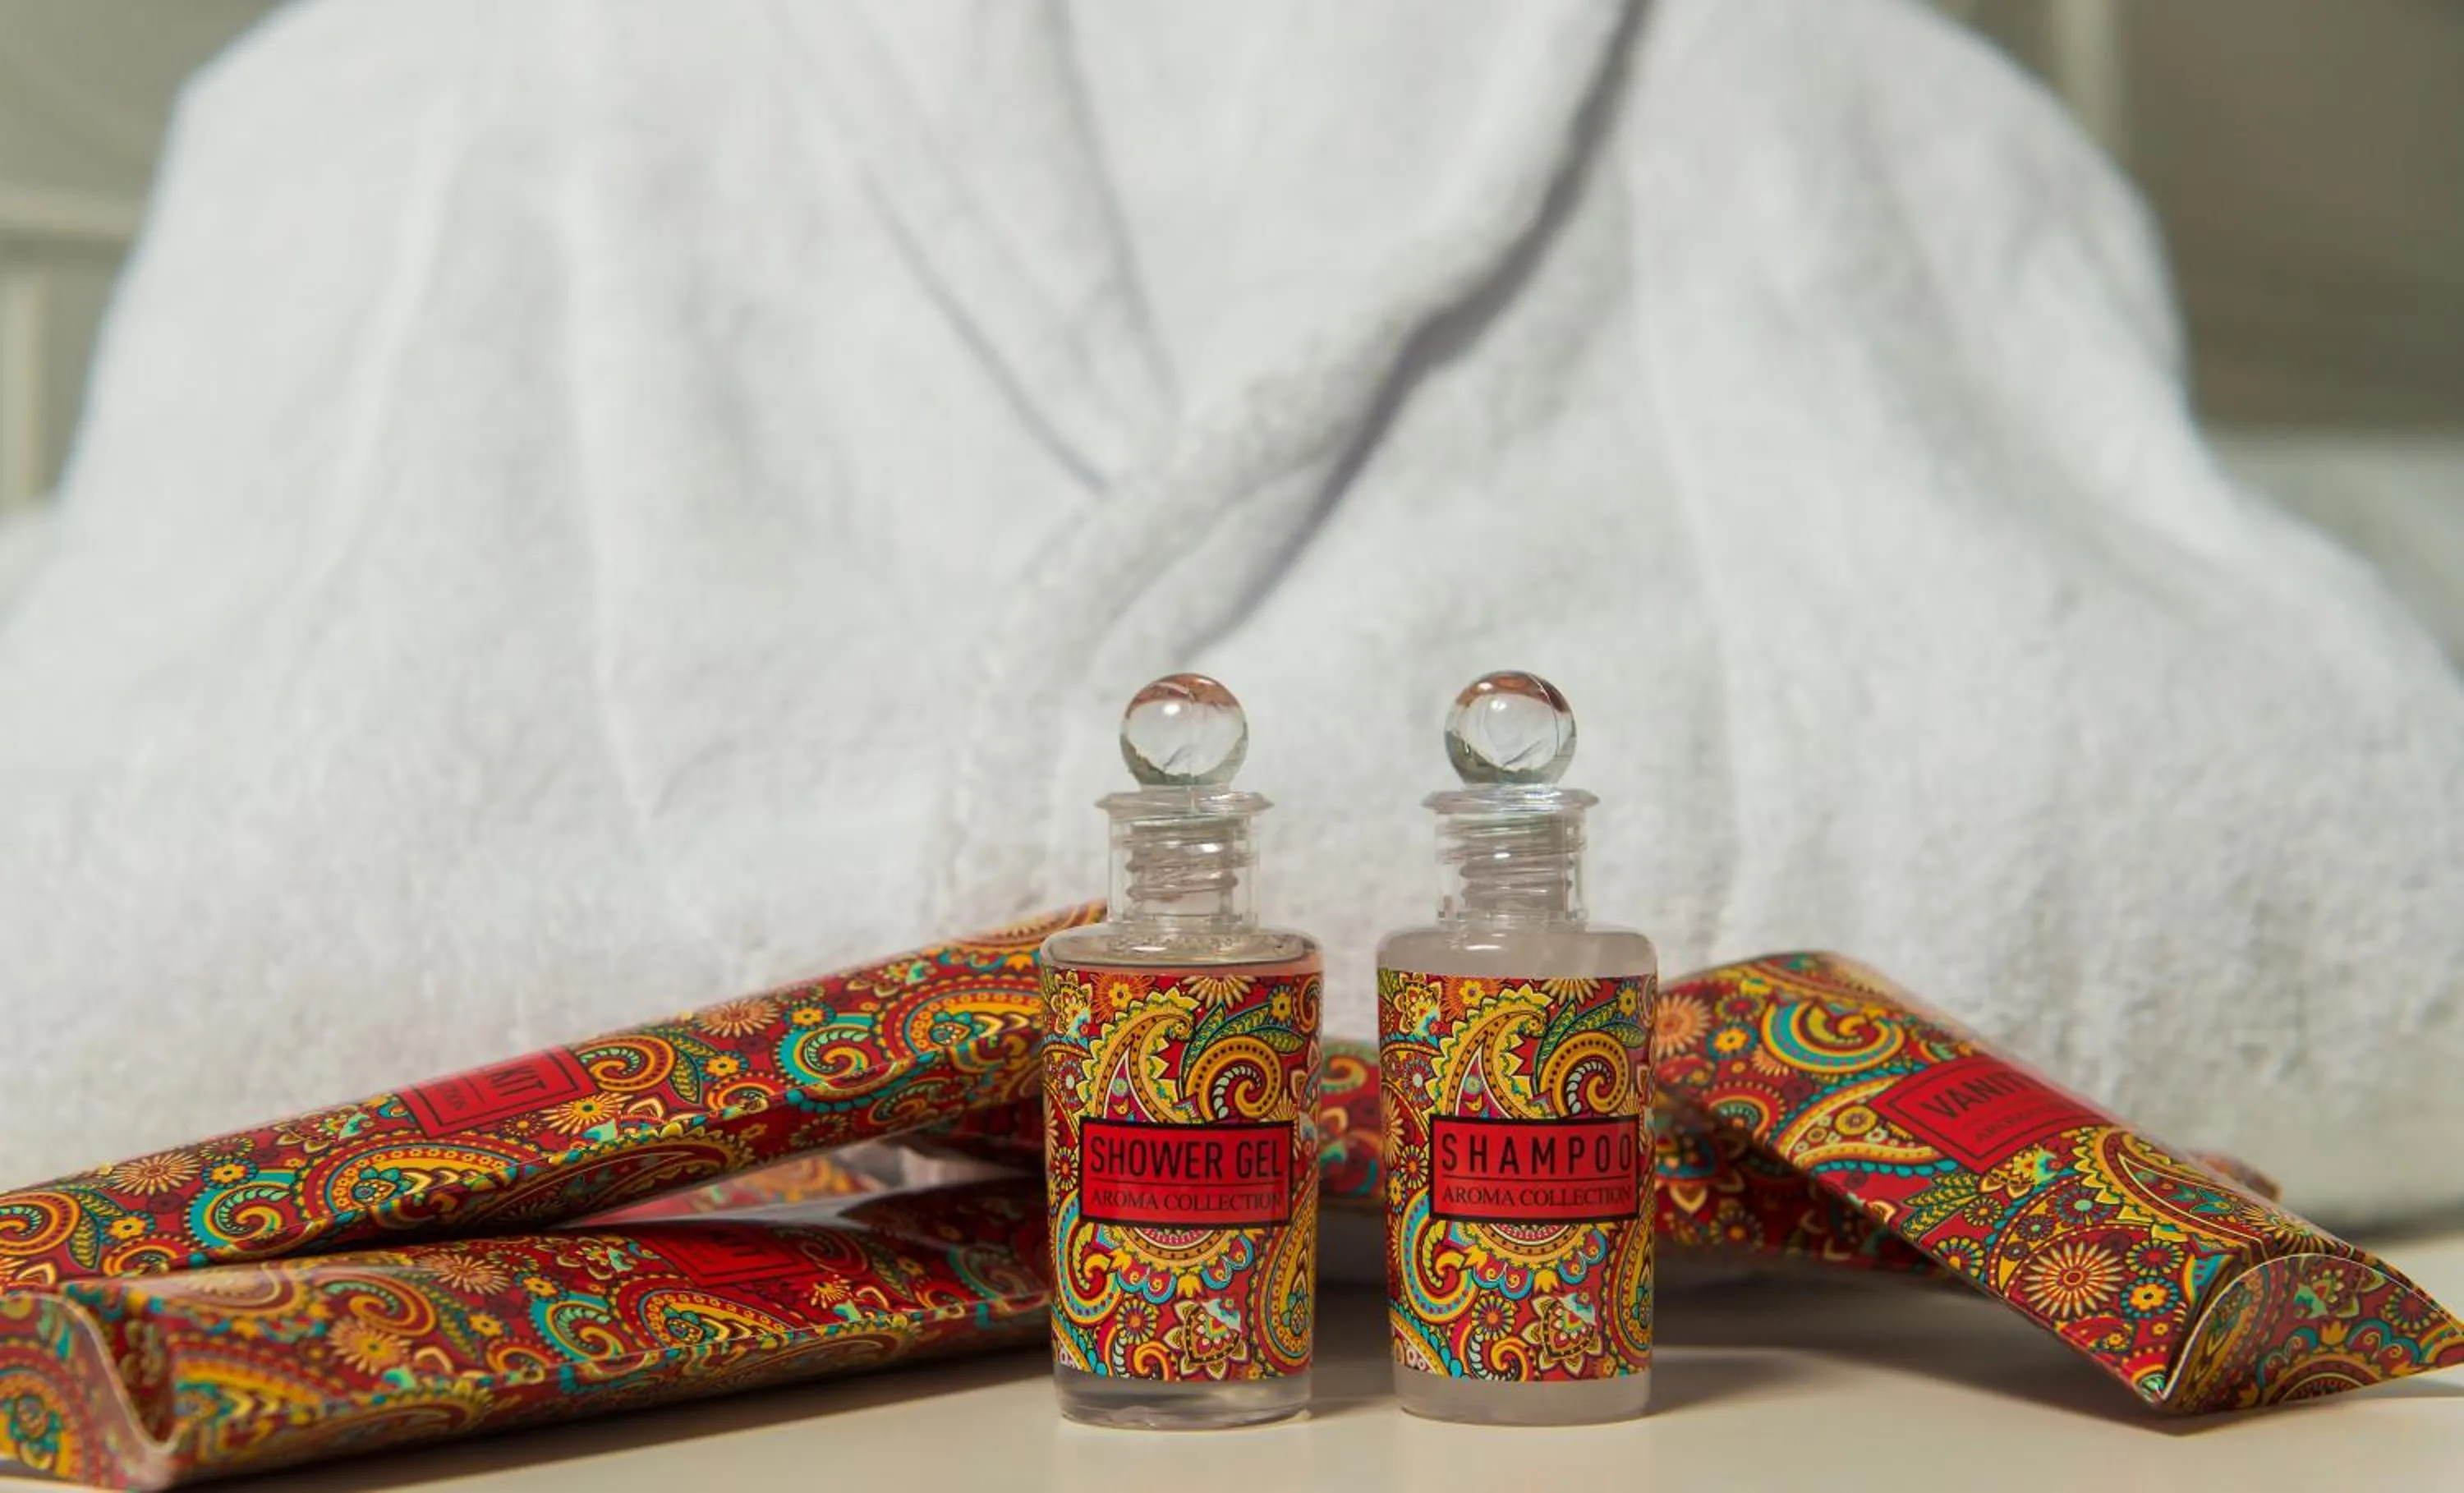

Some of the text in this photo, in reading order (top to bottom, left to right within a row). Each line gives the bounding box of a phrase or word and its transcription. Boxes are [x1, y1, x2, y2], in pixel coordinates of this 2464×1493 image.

[490, 1064, 547, 1097] KIT
[1089, 1135, 1284, 1180] SHOWER GEL
[1441, 1132, 1632, 1175] SHAMPOO
[1090, 1188, 1283, 1212] AROMA COLLECTION
[1441, 1185, 1632, 1207] AROMA COLLECTION
